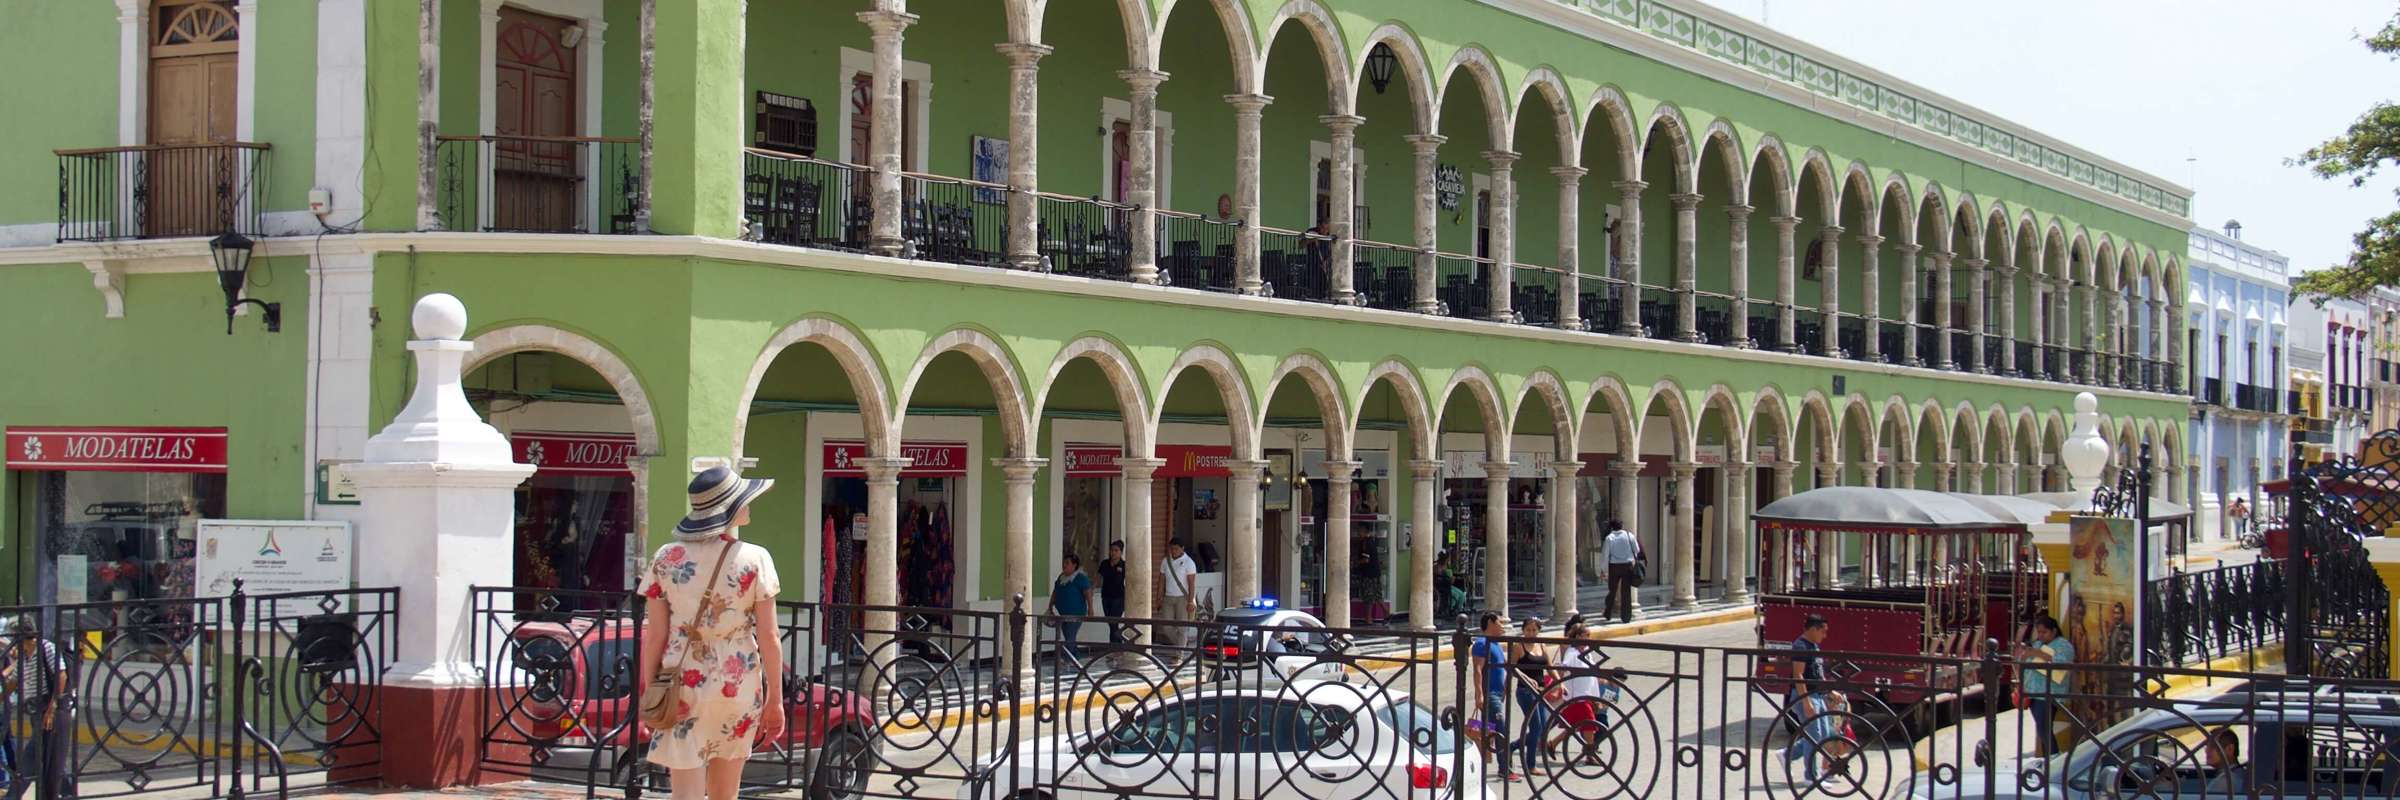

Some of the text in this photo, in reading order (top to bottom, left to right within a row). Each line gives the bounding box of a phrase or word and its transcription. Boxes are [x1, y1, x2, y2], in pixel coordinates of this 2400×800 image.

[64, 437, 195, 459] MODATELAS
[565, 442, 637, 464] MODAT
[1080, 454, 1119, 465] MODATEL
